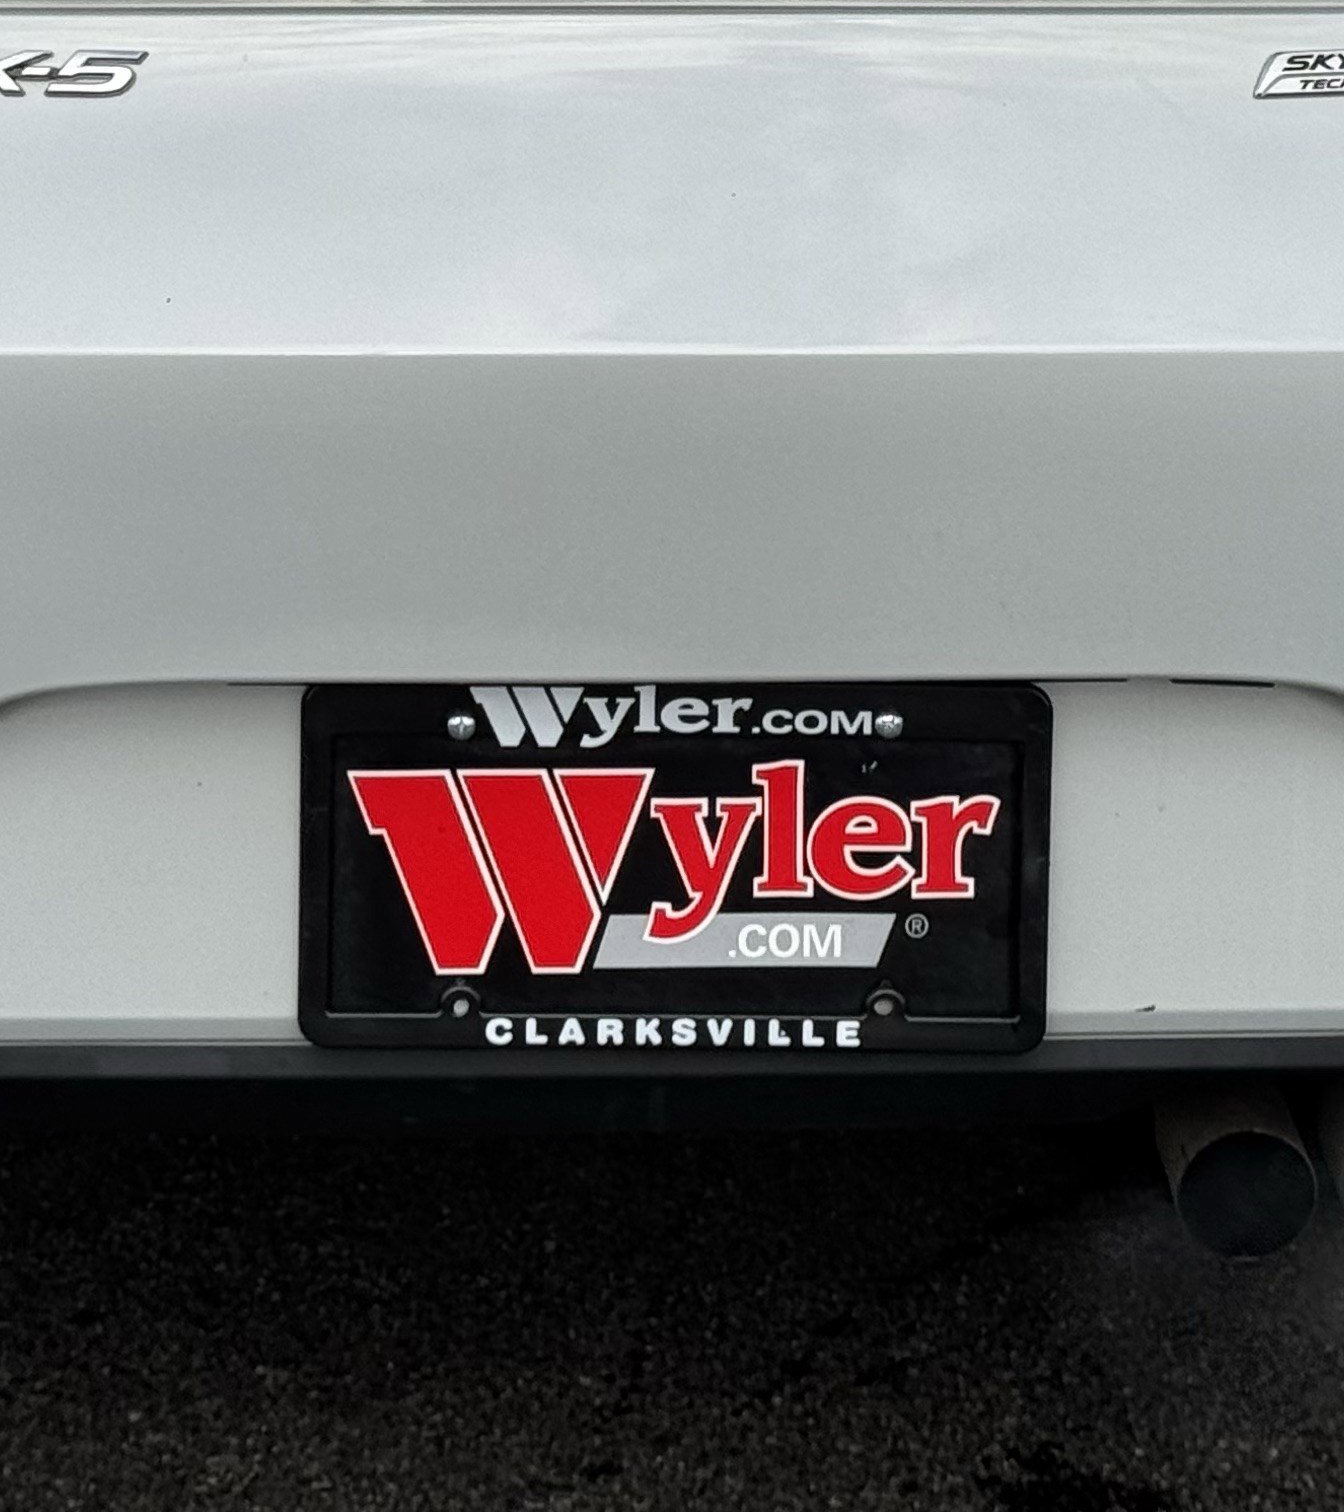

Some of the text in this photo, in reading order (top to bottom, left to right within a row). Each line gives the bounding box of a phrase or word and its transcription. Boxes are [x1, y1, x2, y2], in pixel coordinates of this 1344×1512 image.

[346, 758, 1001, 975] Wyler
[728, 922, 842, 958] .COM
[484, 1017, 861, 1048] CLARKSVILLE
